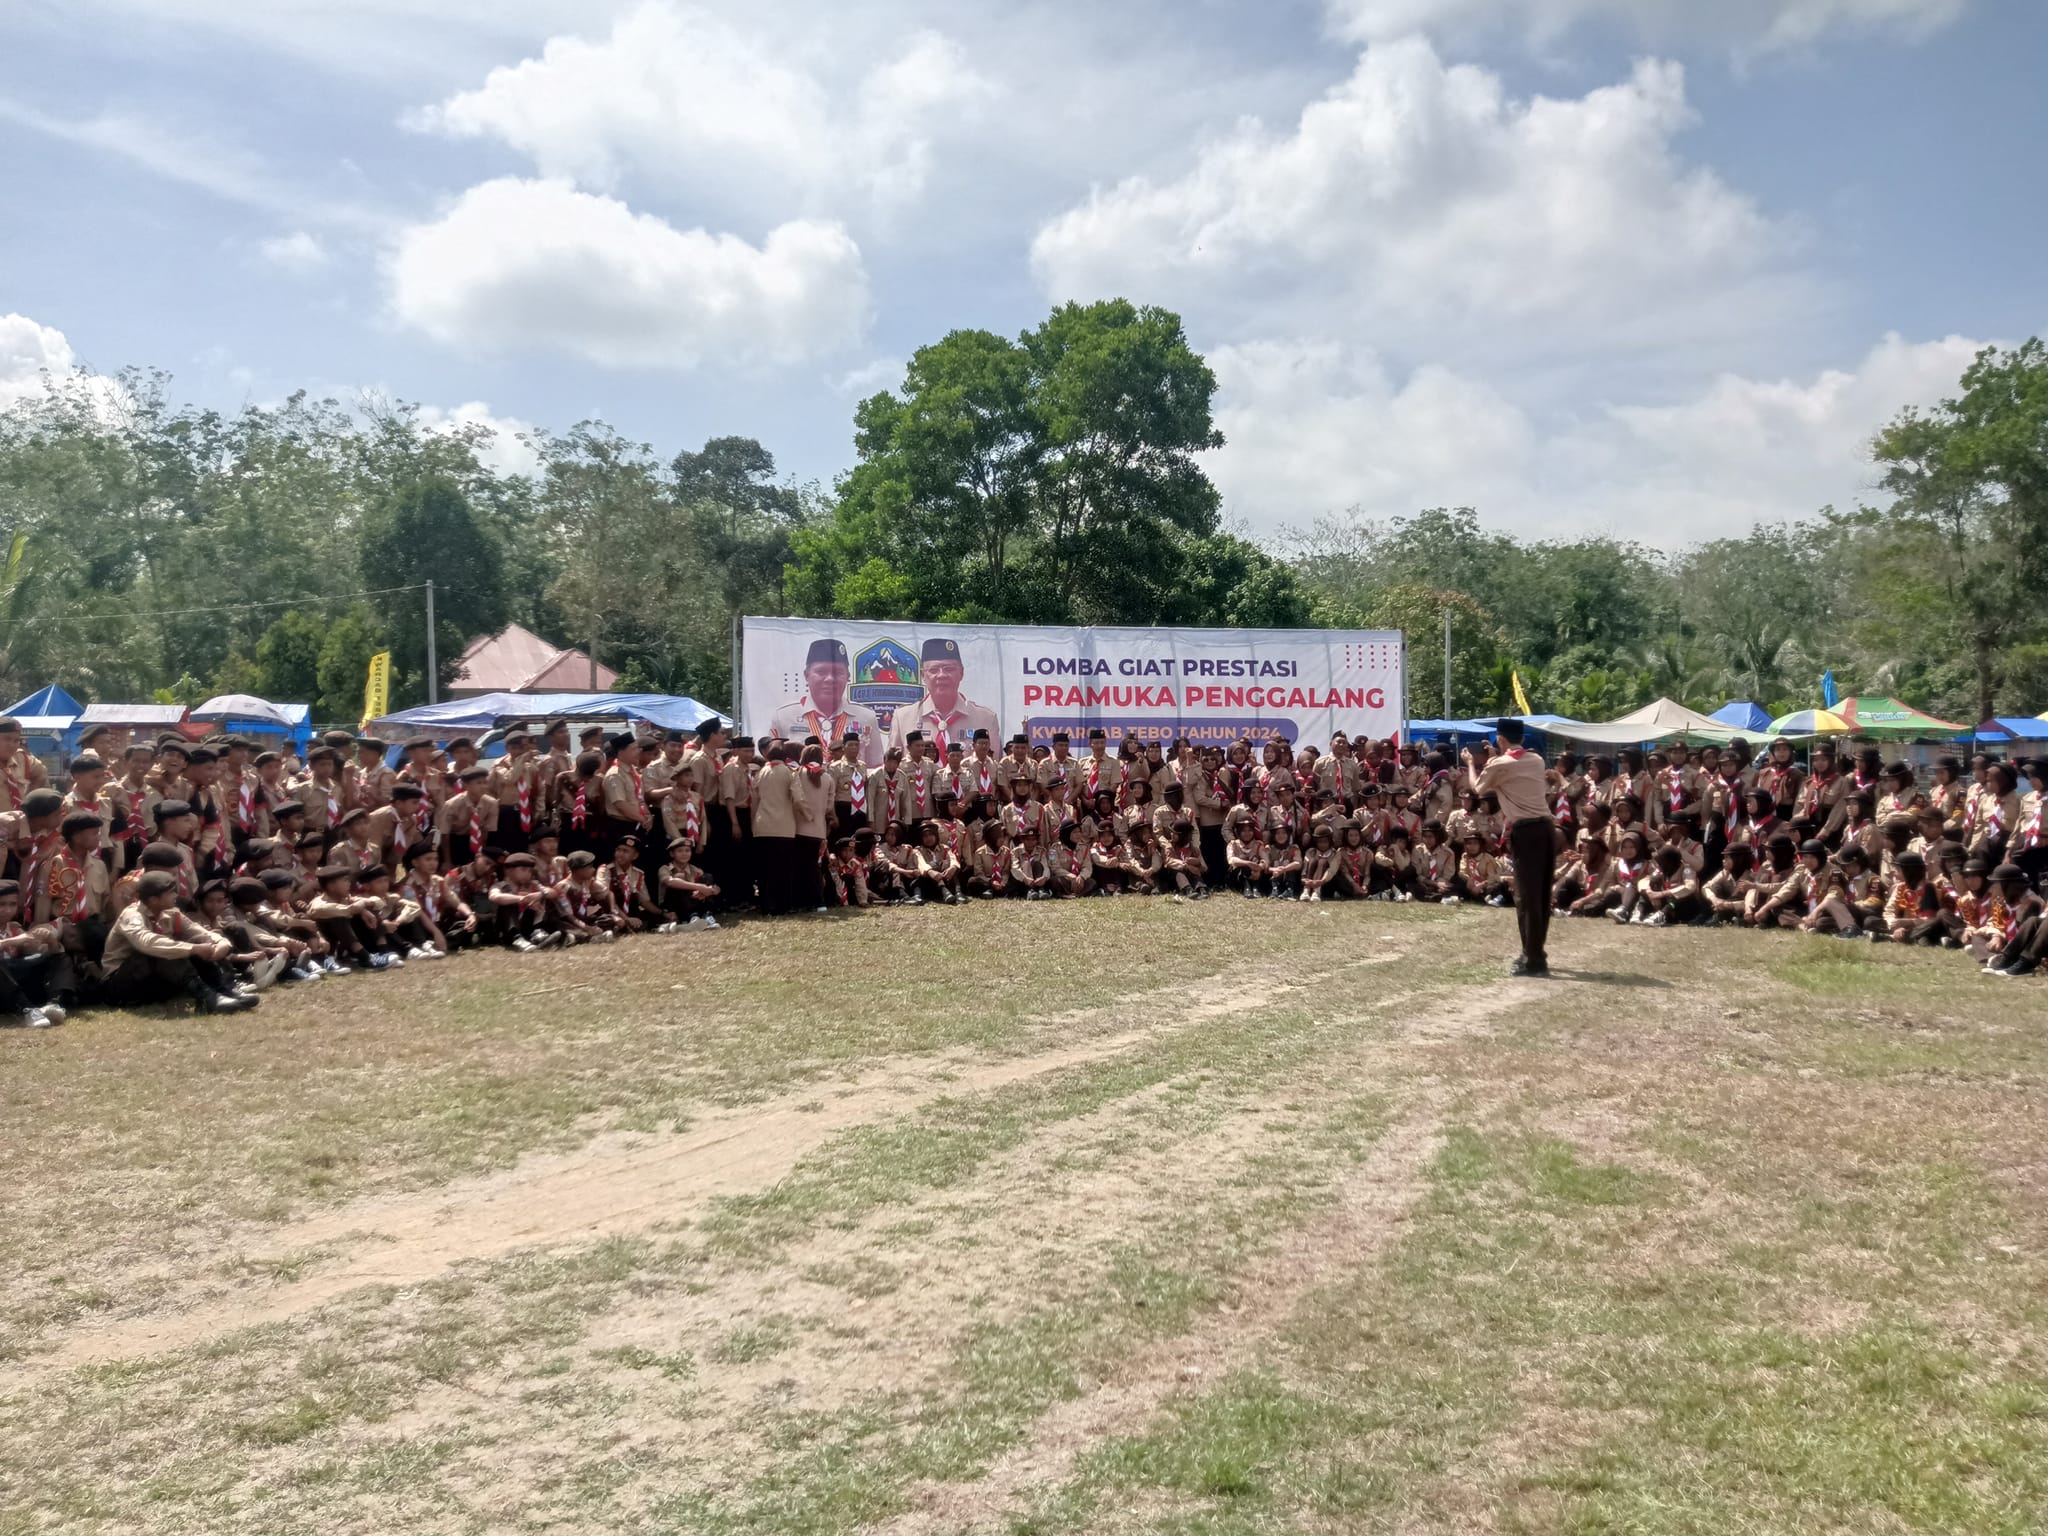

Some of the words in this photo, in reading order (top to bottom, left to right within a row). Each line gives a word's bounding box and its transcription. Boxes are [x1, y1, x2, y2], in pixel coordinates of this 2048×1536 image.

[1023, 658, 1111, 675] LOMBA
[1119, 659, 1175, 675] GIAT
[1183, 660, 1297, 677] PRESTASI
[1024, 685, 1176, 706] PRAMUKA
[1186, 686, 1384, 708] PENGGALANG
[1126, 727, 1173, 739] TEBO
[1178, 726, 1237, 739] TAHUN
[1241, 727, 1281, 739] 2024
